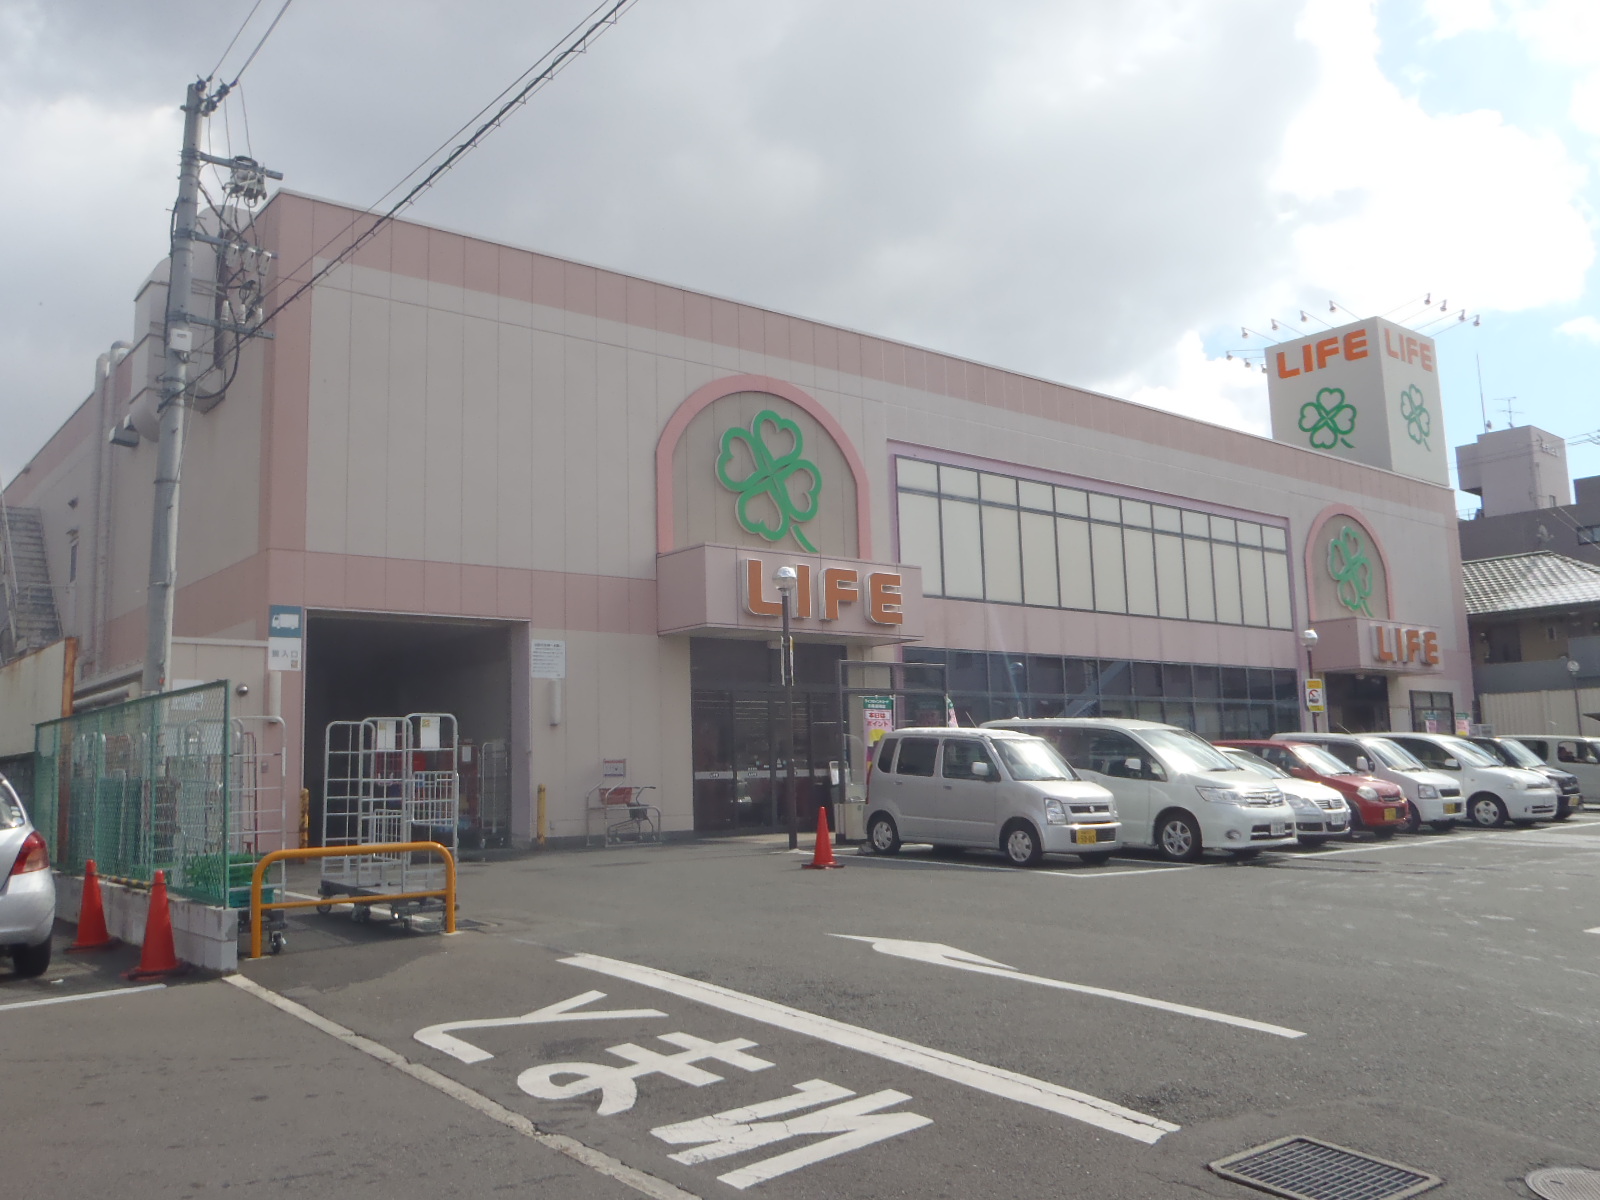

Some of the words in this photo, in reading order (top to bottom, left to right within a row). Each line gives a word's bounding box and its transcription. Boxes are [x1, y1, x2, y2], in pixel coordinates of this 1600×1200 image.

[1276, 328, 1369, 379] LIFE
[1384, 327, 1434, 373] LIFE
[741, 557, 903, 625] LIFE
[1370, 624, 1439, 665] LIFE
[867, 720, 889, 728] ポイント
[412, 989, 934, 1190] とまれ
